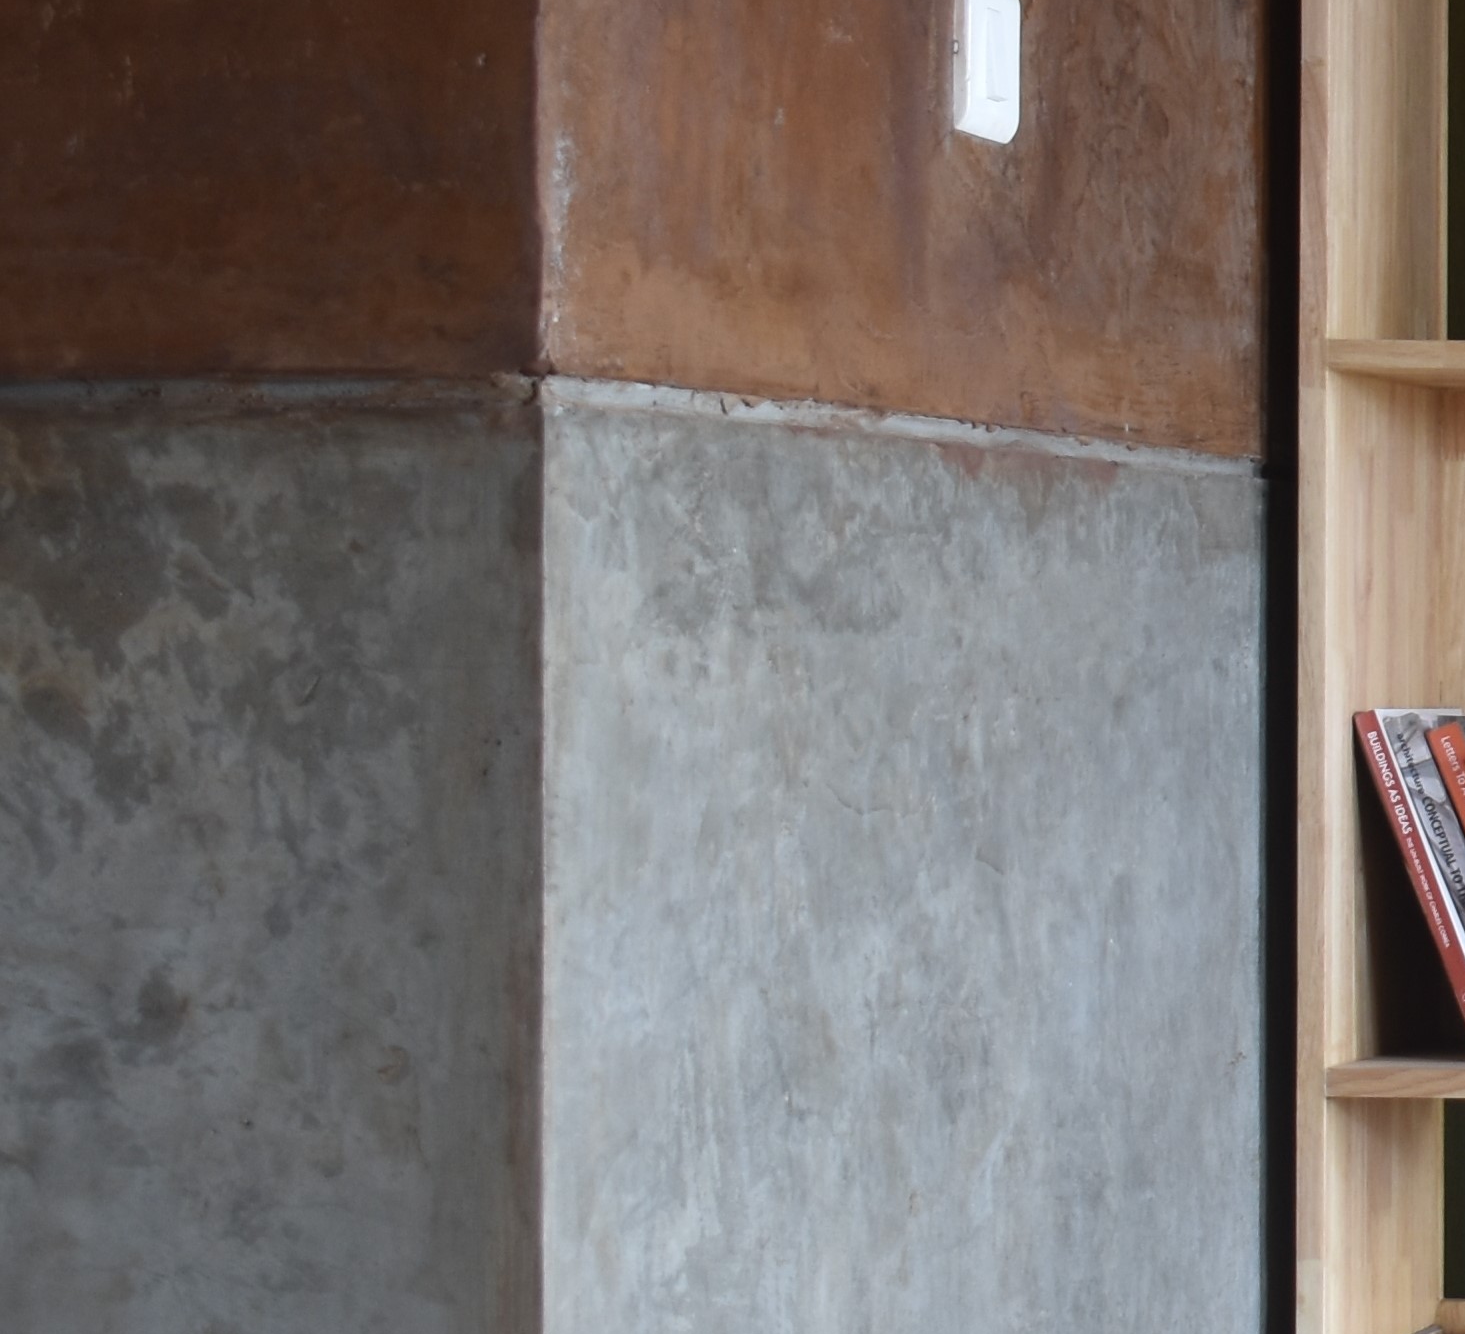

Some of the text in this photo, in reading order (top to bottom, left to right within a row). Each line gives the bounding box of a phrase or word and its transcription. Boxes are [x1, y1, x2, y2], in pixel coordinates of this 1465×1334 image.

[1366, 730, 1413, 834] BUILDINGS AS IDEAS
[1440, 735, 1462, 771] Letters
[1395, 731, 1426, 796] architecture
[1420, 795, 1457, 868] CONCEPTUAL
[1449, 867, 1464, 885] TO
